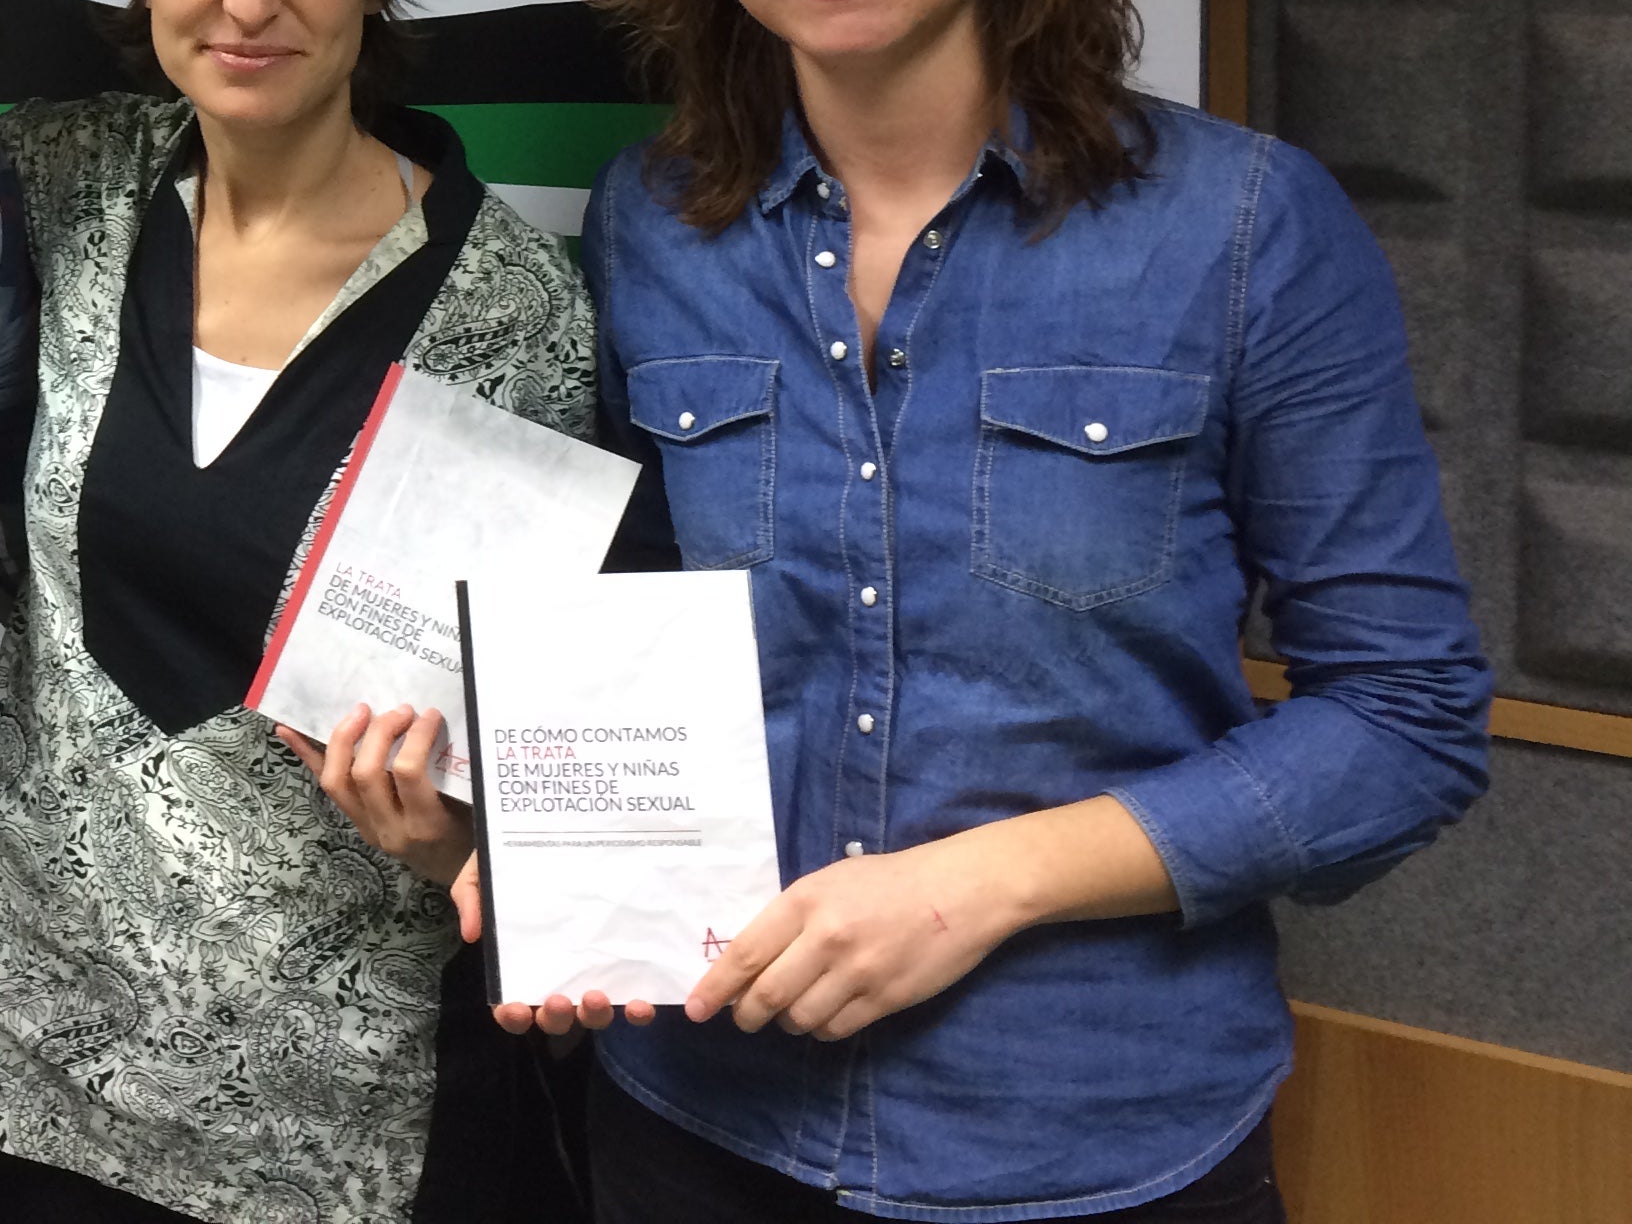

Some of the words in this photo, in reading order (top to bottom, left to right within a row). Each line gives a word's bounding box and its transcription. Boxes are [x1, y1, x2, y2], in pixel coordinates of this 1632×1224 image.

[335, 561, 353, 575] LA
[358, 569, 402, 599] TRATA
[328, 574, 351, 593] DE
[351, 584, 418, 623] MUJERES
[419, 613, 432, 627] Y
[324, 588, 360, 611] CON
[359, 604, 401, 631] FINES
[402, 622, 424, 642] DE
[318, 601, 420, 656] EXPLOTACIÓN
[494, 728, 517, 743] DE
[520, 725, 577, 743] CÓMO
[581, 726, 688, 743] CONTAMOS
[496, 746, 516, 761] LA
[523, 745, 576, 761] TRATA
[497, 763, 521, 778] DE
[524, 762, 604, 778] MUJERES
[607, 762, 620, 777] Y
[623, 759, 680, 777] NIÑAS
[498, 780, 538, 795] CON
[542, 780, 591, 795] FINES
[596, 779, 620, 795] DE
[500, 793, 622, 813] EXPLOTACIÓN
[626, 796, 696, 812] SEXUAL
